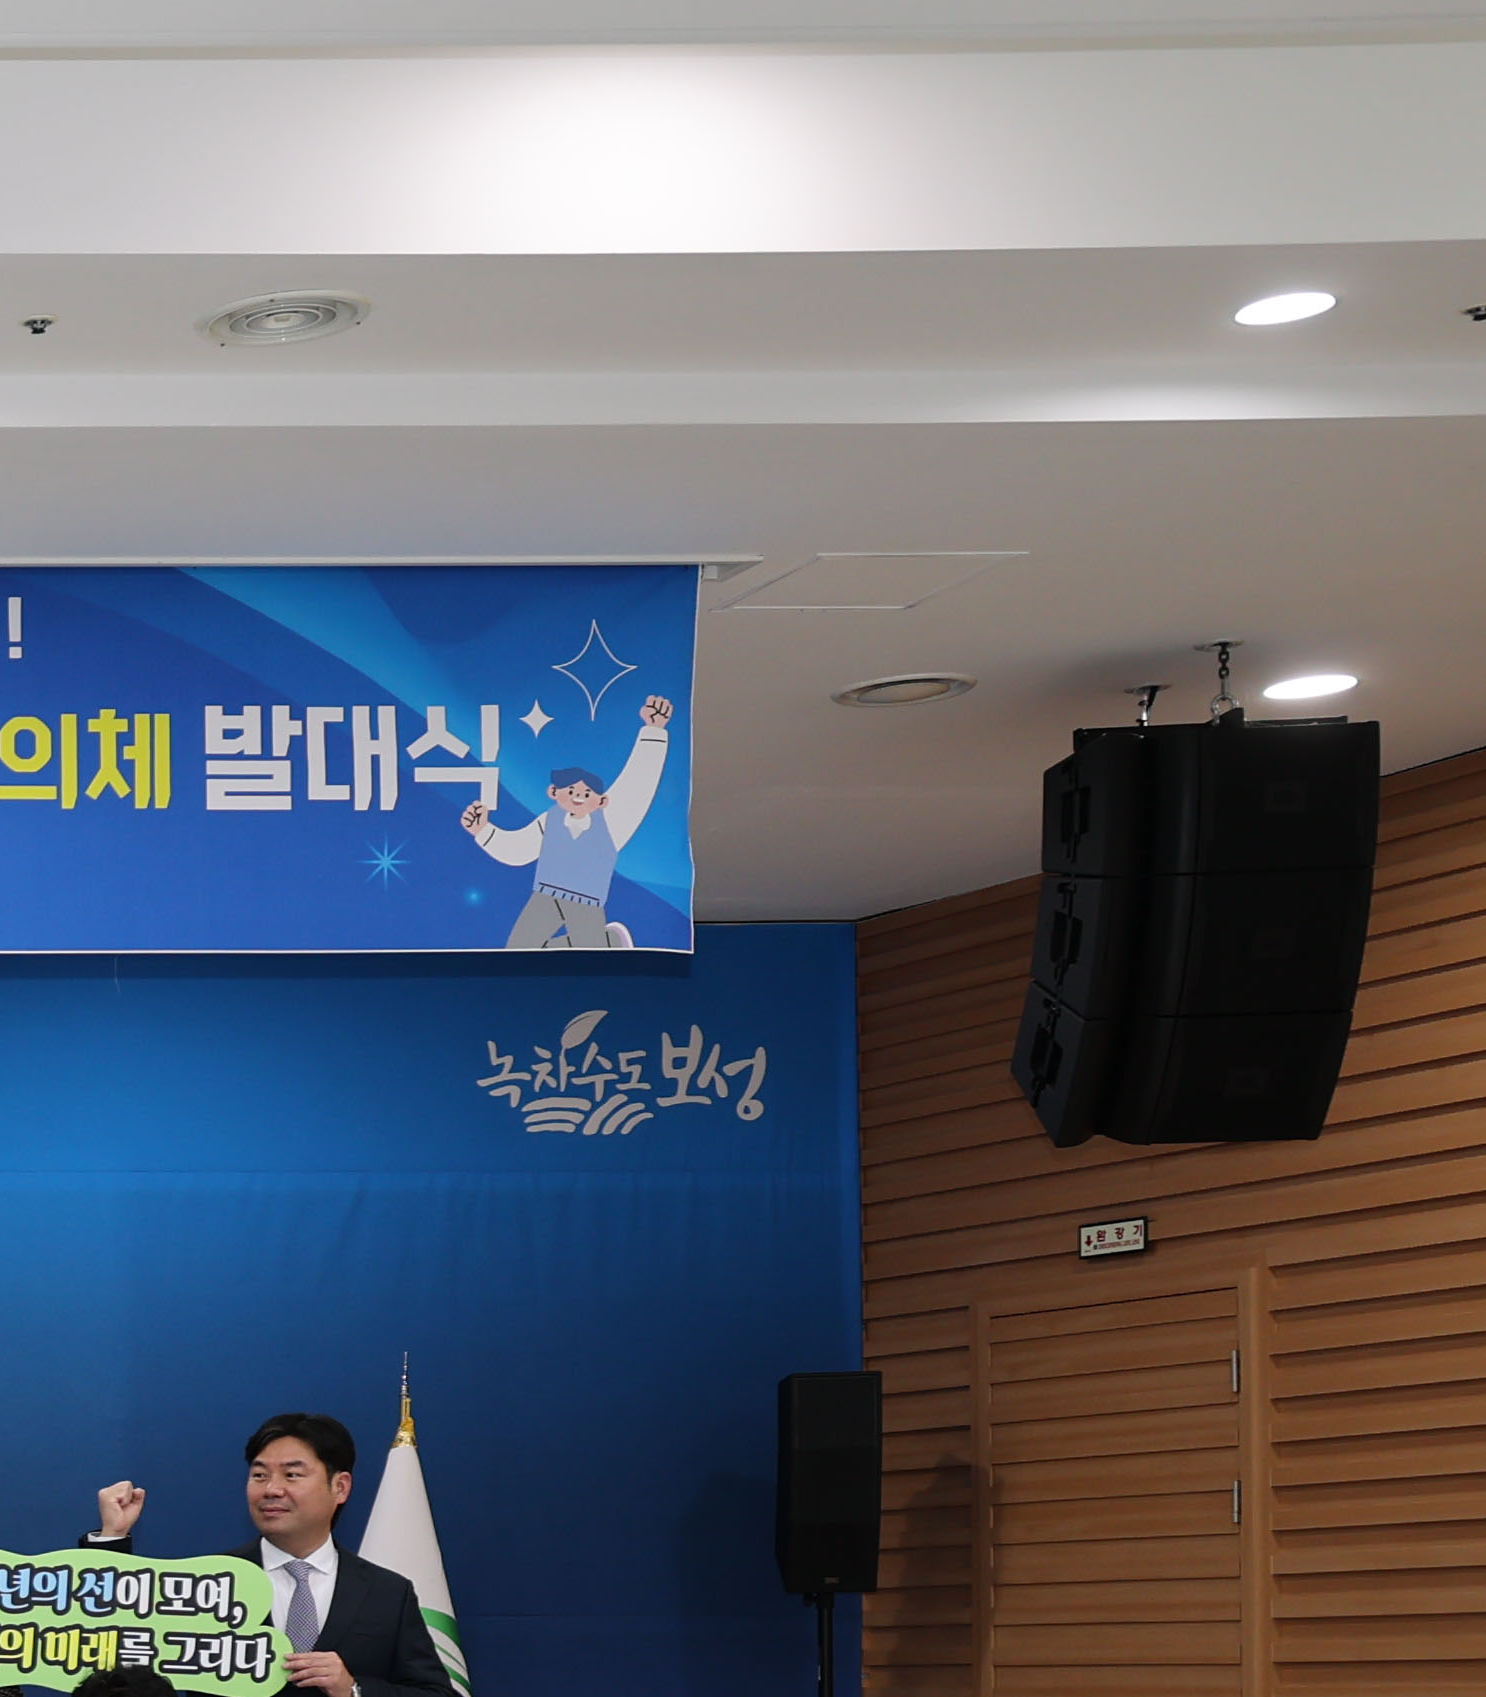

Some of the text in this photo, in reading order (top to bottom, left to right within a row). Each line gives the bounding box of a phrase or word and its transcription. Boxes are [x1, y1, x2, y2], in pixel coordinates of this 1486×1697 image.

[204, 704, 501, 813] 발대식
[476, 1023, 768, 1121] 녹차수도 보성
[75, 1567, 152, 1616] 선이
[160, 1571, 248, 1626] 모여,
[41, 1625, 154, 1672] 미래를
[162, 1631, 274, 1682] 그리다
